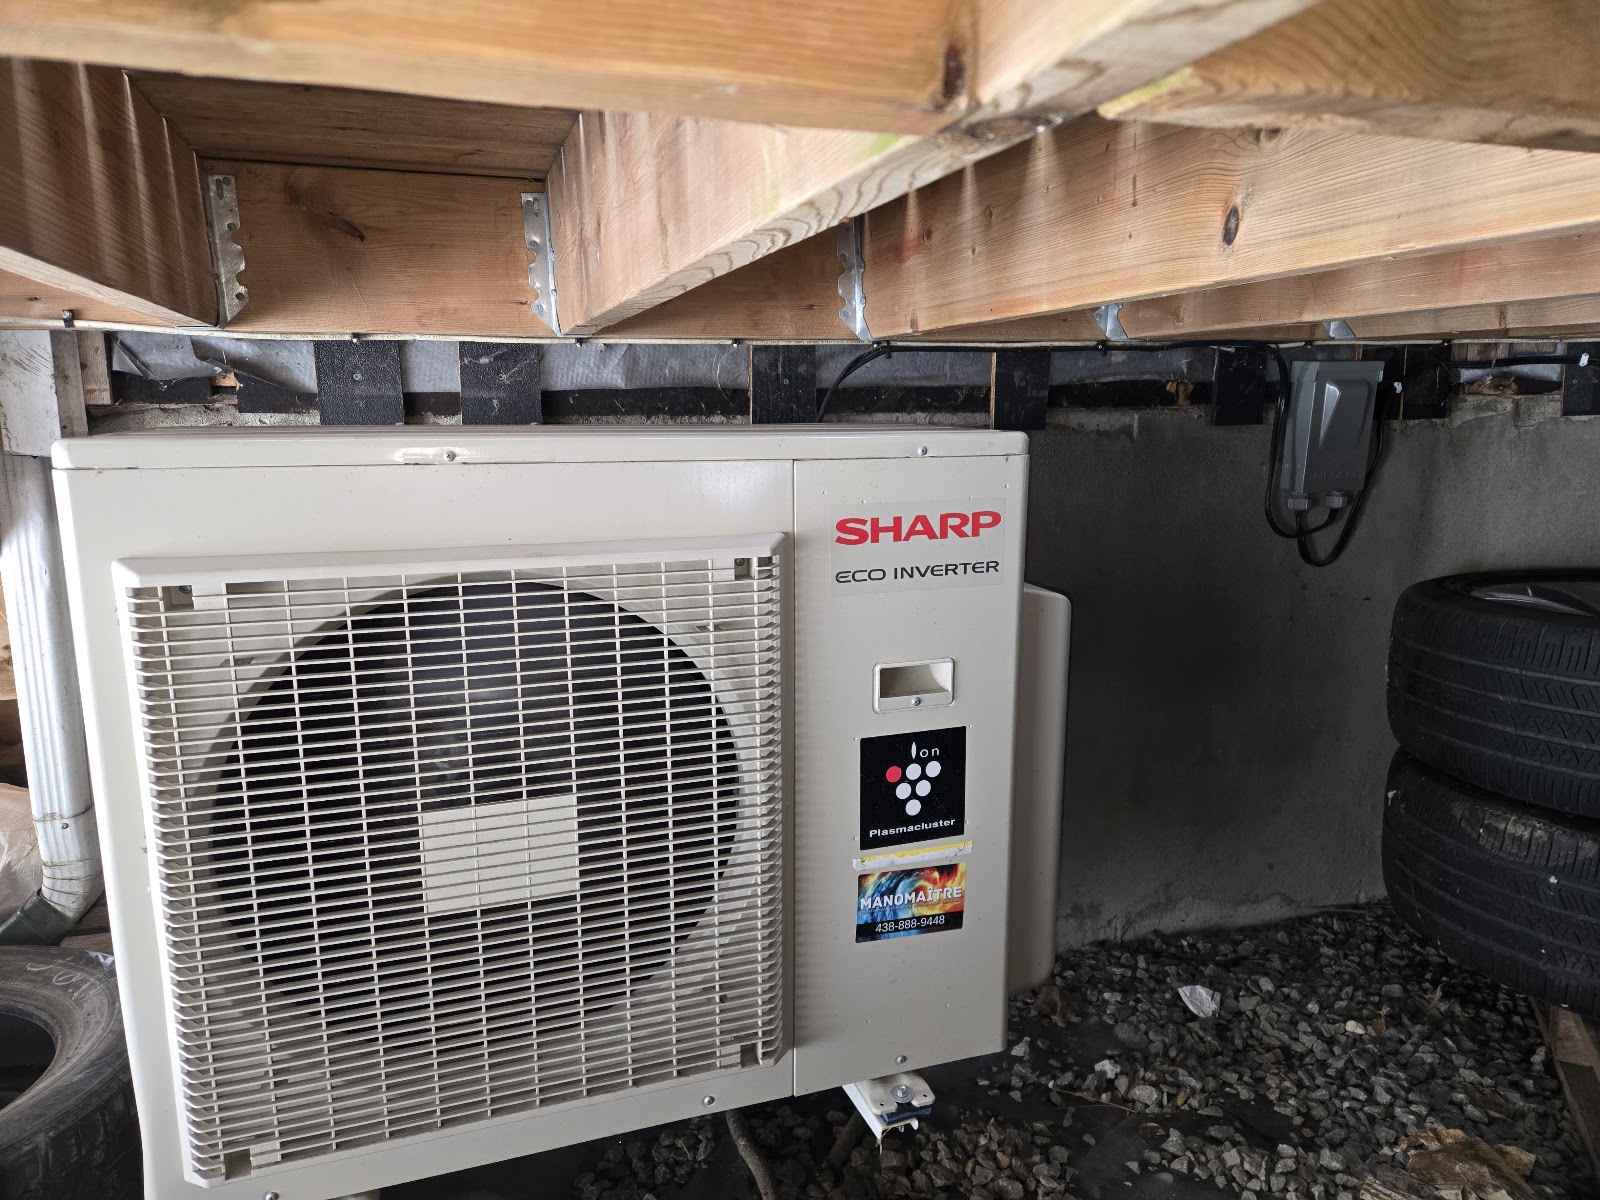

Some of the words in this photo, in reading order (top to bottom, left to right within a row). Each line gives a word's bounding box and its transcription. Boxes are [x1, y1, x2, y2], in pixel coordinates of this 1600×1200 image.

[835, 510, 1001, 545] SHARP
[835, 568, 886, 583] ECO
[893, 560, 999, 579] INVERTER
[869, 819, 956, 837] Plasmacluster
[860, 886, 962, 910] MANOMAÎTRE
[875, 914, 945, 933] 438-888-9448
